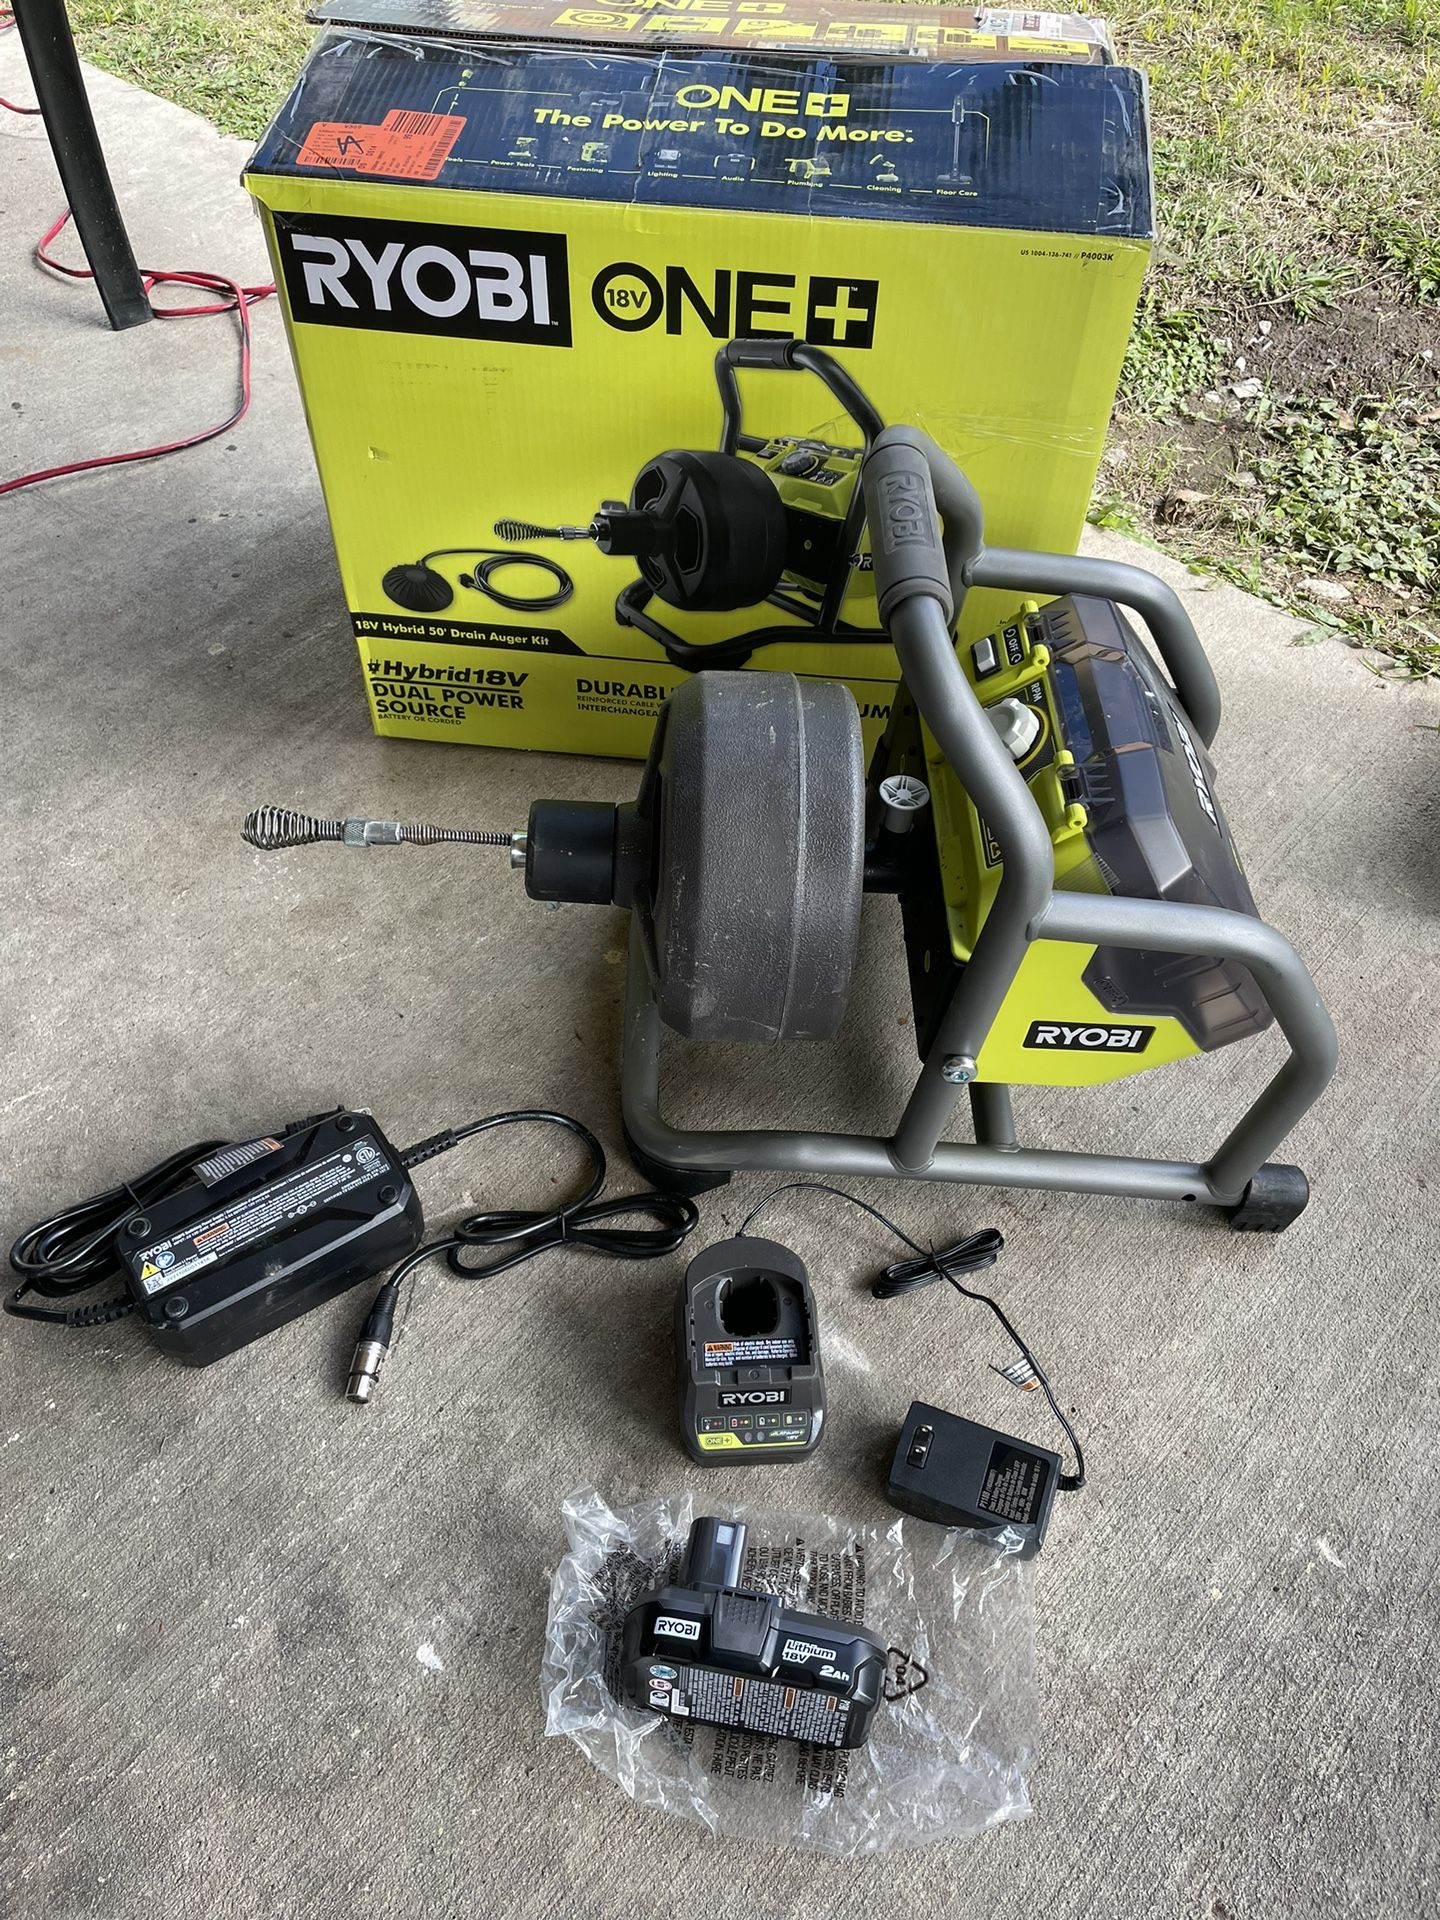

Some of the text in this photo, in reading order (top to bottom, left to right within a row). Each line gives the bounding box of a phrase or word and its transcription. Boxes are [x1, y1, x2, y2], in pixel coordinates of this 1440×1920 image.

[534, 108, 914, 144] The Power To Do More.
[516, 161, 536, 169] Tools
[566, 165, 604, 174] Fastening
[647, 171, 678, 180] Lighting
[787, 179, 823, 189] Plumbing
[866, 184, 902, 194] Cleaning
[936, 188, 957, 196] Floor
[1080, 251, 1114, 261] P4003K
[290, 232, 551, 326] RYOBI
[606, 286, 647, 309] 18V
[887, 474, 927, 548] RYOBI
[355, 620, 379, 632] 18V
[382, 622, 426, 636] Hybrid
[450, 628, 486, 641] Drain
[489, 632, 528, 645] Auger
[531, 635, 550, 646] Kit
[371, 683, 525, 710] DUAL POWER
[576, 678, 675, 701] DURABL
[1030, 681, 1043, 702] RPM
[375, 699, 467, 720] SOURCE
[576, 695, 628, 706] REINFORCED
[629, 699, 654, 708] CABLE
[378, 713, 462, 726] BATTERY OR CORDED
[1033, 1024, 1144, 1049] RYOBI
[139, 1240, 173, 1262] RYOBI
[721, 1391, 785, 1405] RYOBI
[657, 1619, 698, 1636] RYOBI
[783, 1651, 808, 1663] 18V
[787, 1641, 835, 1660] Lithium
[819, 1665, 850, 1682] 2Ah
[710, 1752, 723, 1774] FAIRE
[723, 1755, 736, 1777] PEUT
[749, 1765, 761, 1781] PAS
[762, 1752, 776, 1782] GARDEZ
